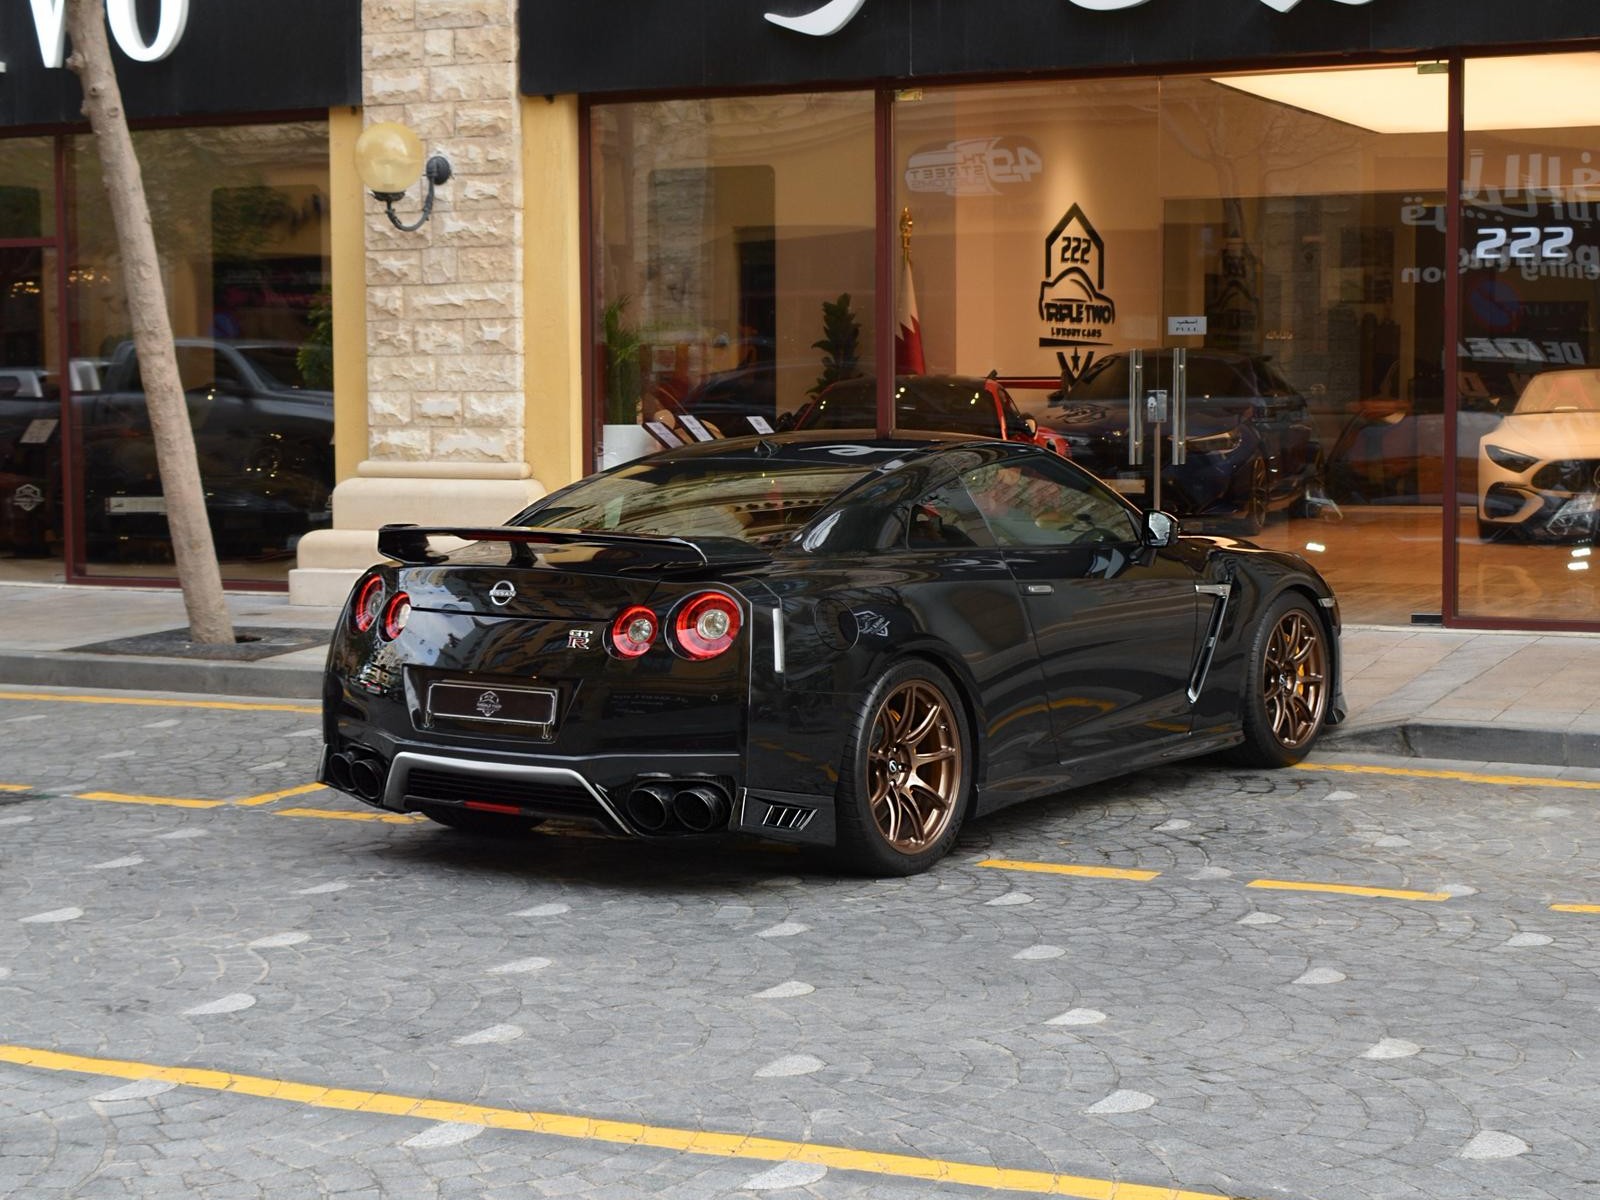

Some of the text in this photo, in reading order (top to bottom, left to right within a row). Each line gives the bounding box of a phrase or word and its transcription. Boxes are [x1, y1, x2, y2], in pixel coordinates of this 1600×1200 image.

[1061, 236, 1091, 264] 222
[1476, 227, 1573, 258] 222
[1044, 302, 1111, 325] TRIPLE TWO
[1082, 328, 1102, 338] CARS
